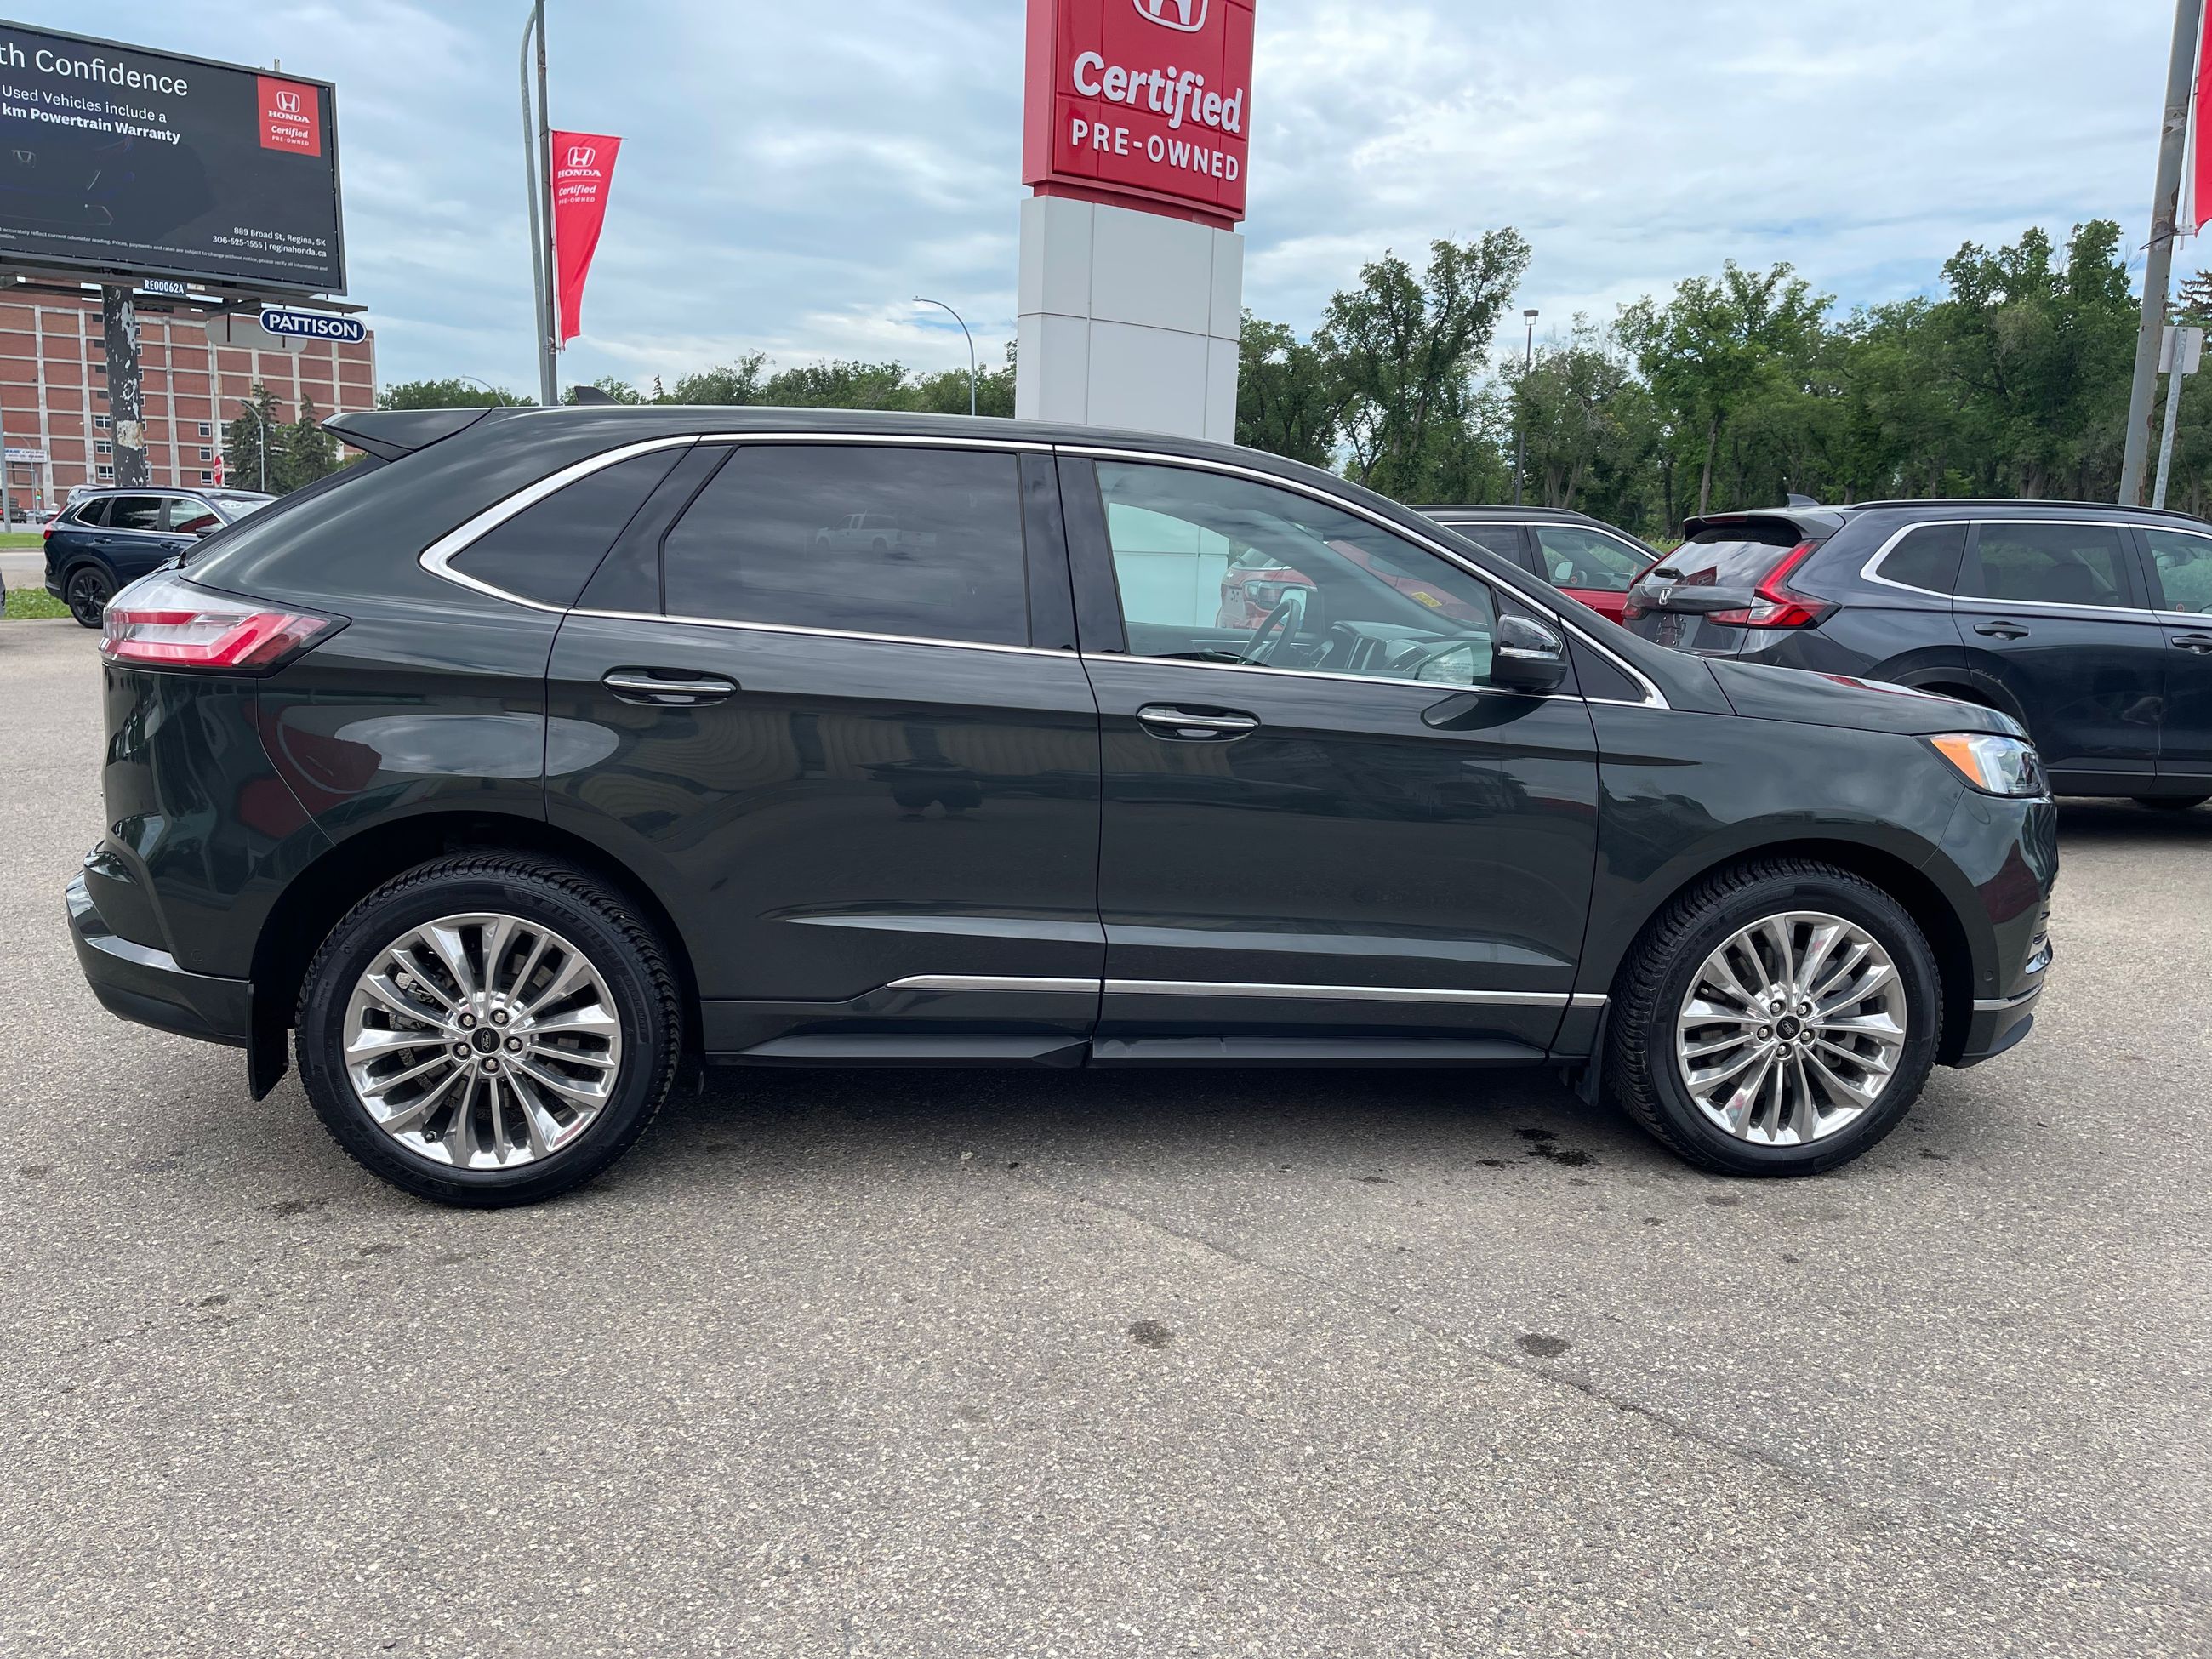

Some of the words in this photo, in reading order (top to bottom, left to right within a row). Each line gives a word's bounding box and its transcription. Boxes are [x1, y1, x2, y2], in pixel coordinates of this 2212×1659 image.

[35, 49, 188, 96] Confidence
[1073, 51, 1243, 134] Certified
[2, 84, 39, 102] Used
[43, 91, 102, 112] Vehicles
[105, 101, 155, 121] include
[158, 112, 167, 123] a
[2, 102, 27, 118] km
[30, 107, 111, 132] Powertrain
[114, 121, 180, 145] Warranty
[268, 110, 311, 123] HONDA
[271, 125, 309, 139] Certified
[1072, 118, 1239, 181] PRE-OWNED
[557, 169, 602, 179] HONDA
[558, 184, 597, 197] Certified
[233, 226, 248, 237] 889
[250, 229, 273, 239] Broad
[316, 238, 326, 247] SK
[269, 243, 327, 258] reginahonda.ca
[144, 279, 185, 294] RE00062A
[269, 313, 358, 339] PATTISON
